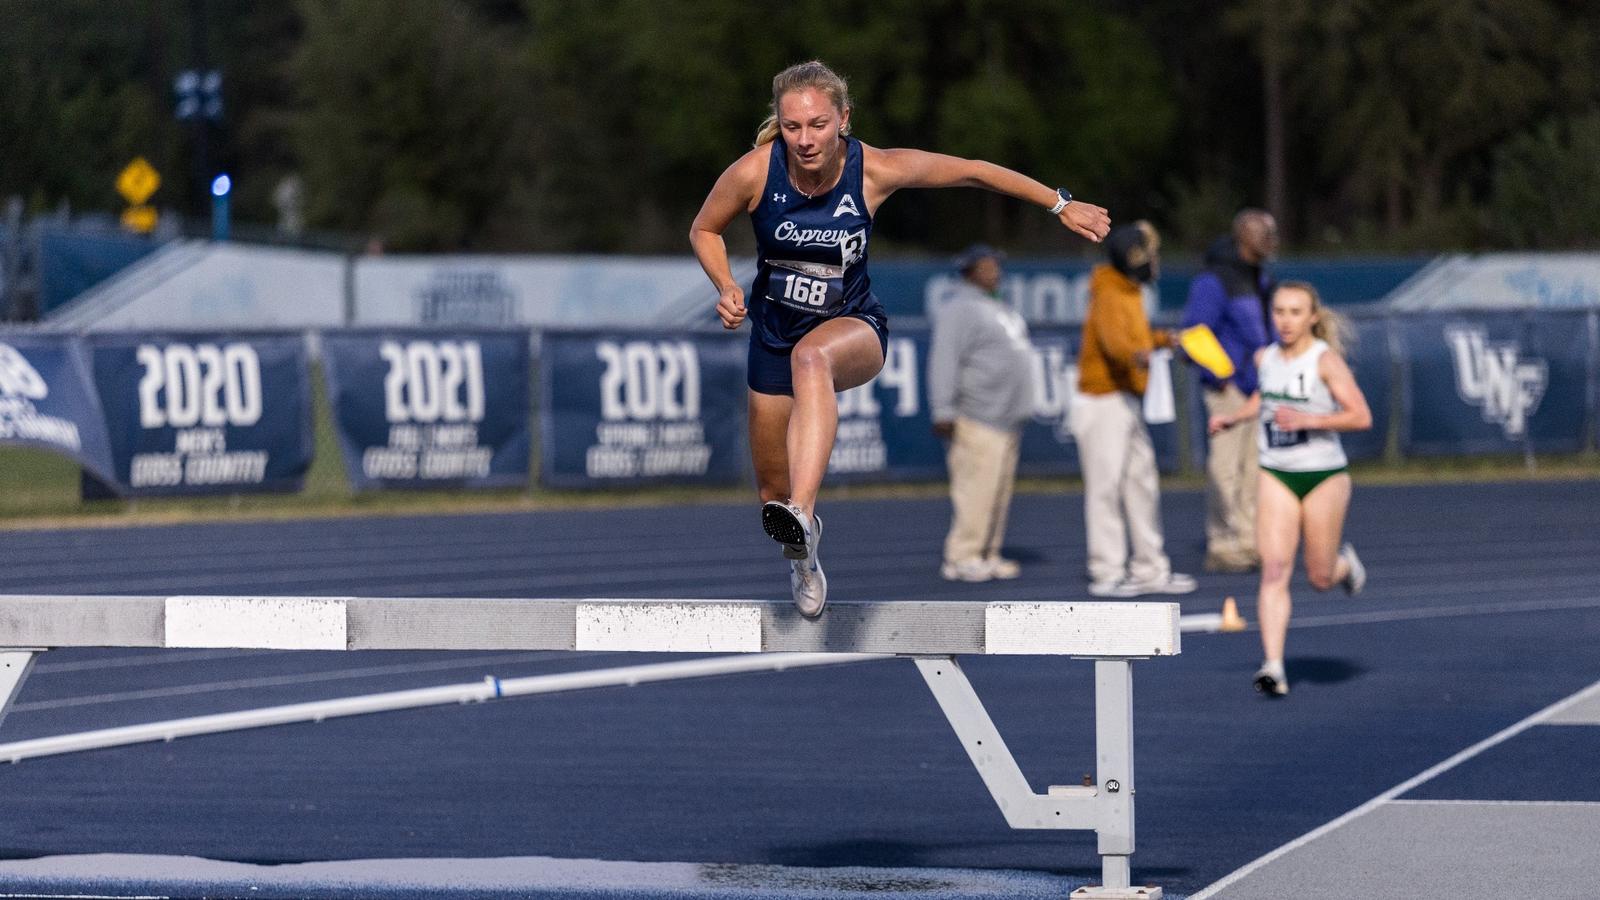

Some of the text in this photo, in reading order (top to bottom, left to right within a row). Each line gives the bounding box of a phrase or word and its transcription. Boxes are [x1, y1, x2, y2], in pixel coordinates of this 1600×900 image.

[783, 274, 828, 307] 168
[136, 343, 262, 428] 2020
[379, 340, 486, 422] 2021
[596, 341, 700, 420] 2021
